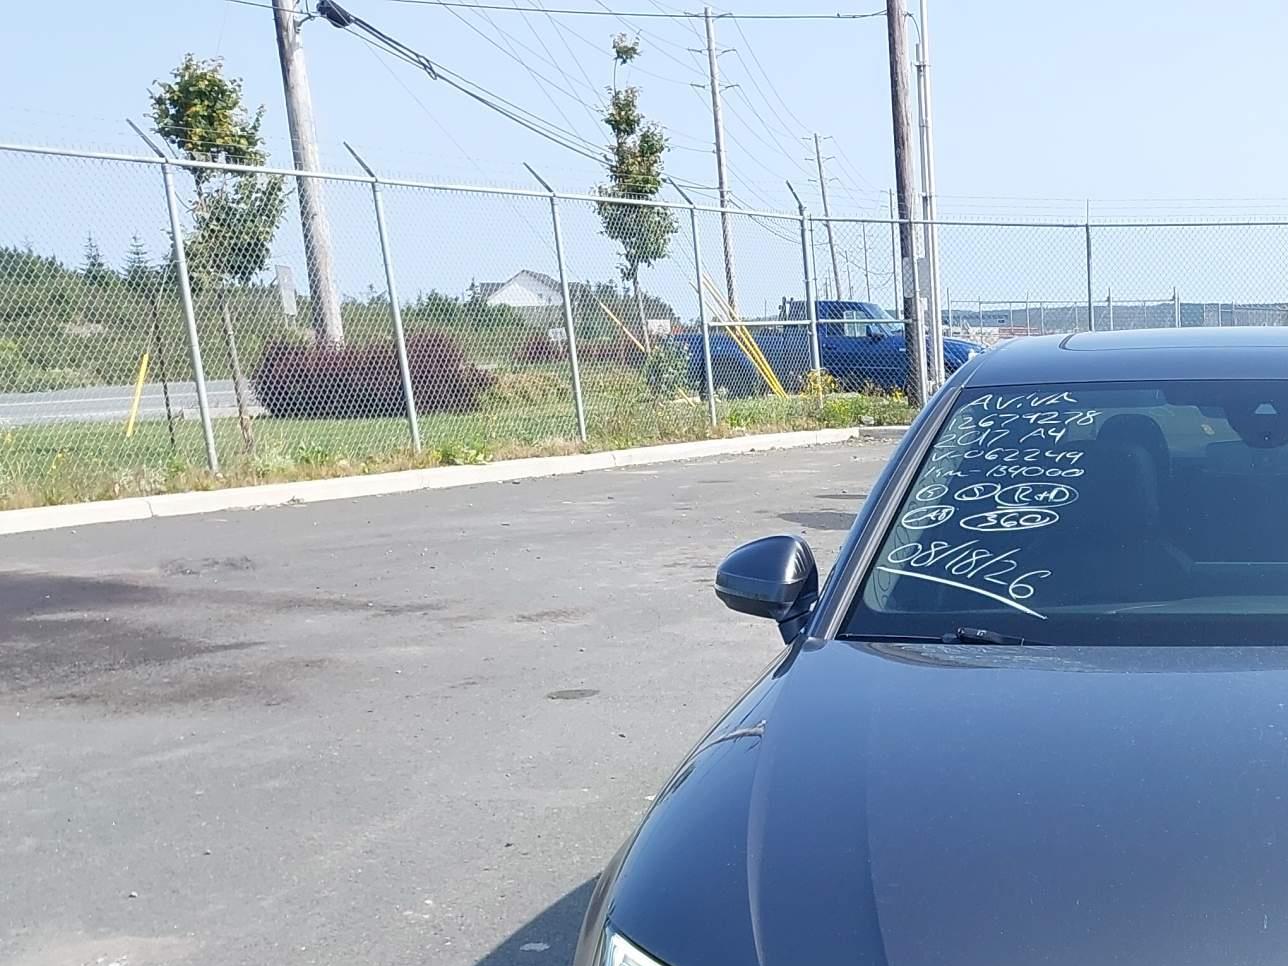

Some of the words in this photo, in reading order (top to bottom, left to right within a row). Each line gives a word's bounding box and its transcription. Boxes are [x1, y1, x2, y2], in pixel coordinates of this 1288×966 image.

[934, 428, 1011, 449] 2017
[1019, 427, 1067, 445] A4
[887, 539, 1052, 600] 08/18/26
